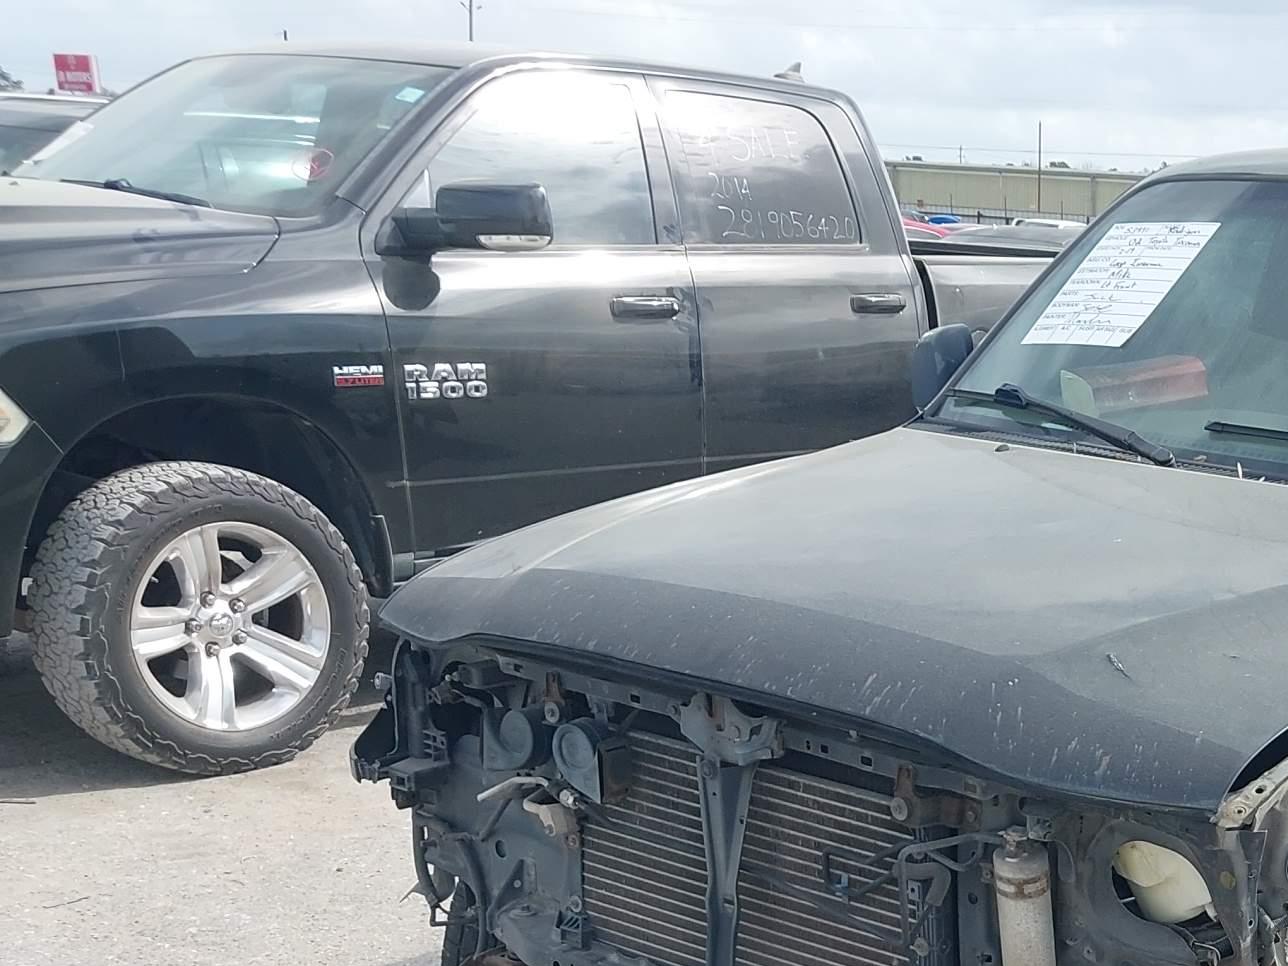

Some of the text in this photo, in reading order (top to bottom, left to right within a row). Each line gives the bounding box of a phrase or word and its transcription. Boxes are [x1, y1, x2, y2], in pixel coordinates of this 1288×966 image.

[332, 364, 384, 377] HEMI
[403, 362, 487, 382] RAM
[405, 380, 488, 400] 1500
